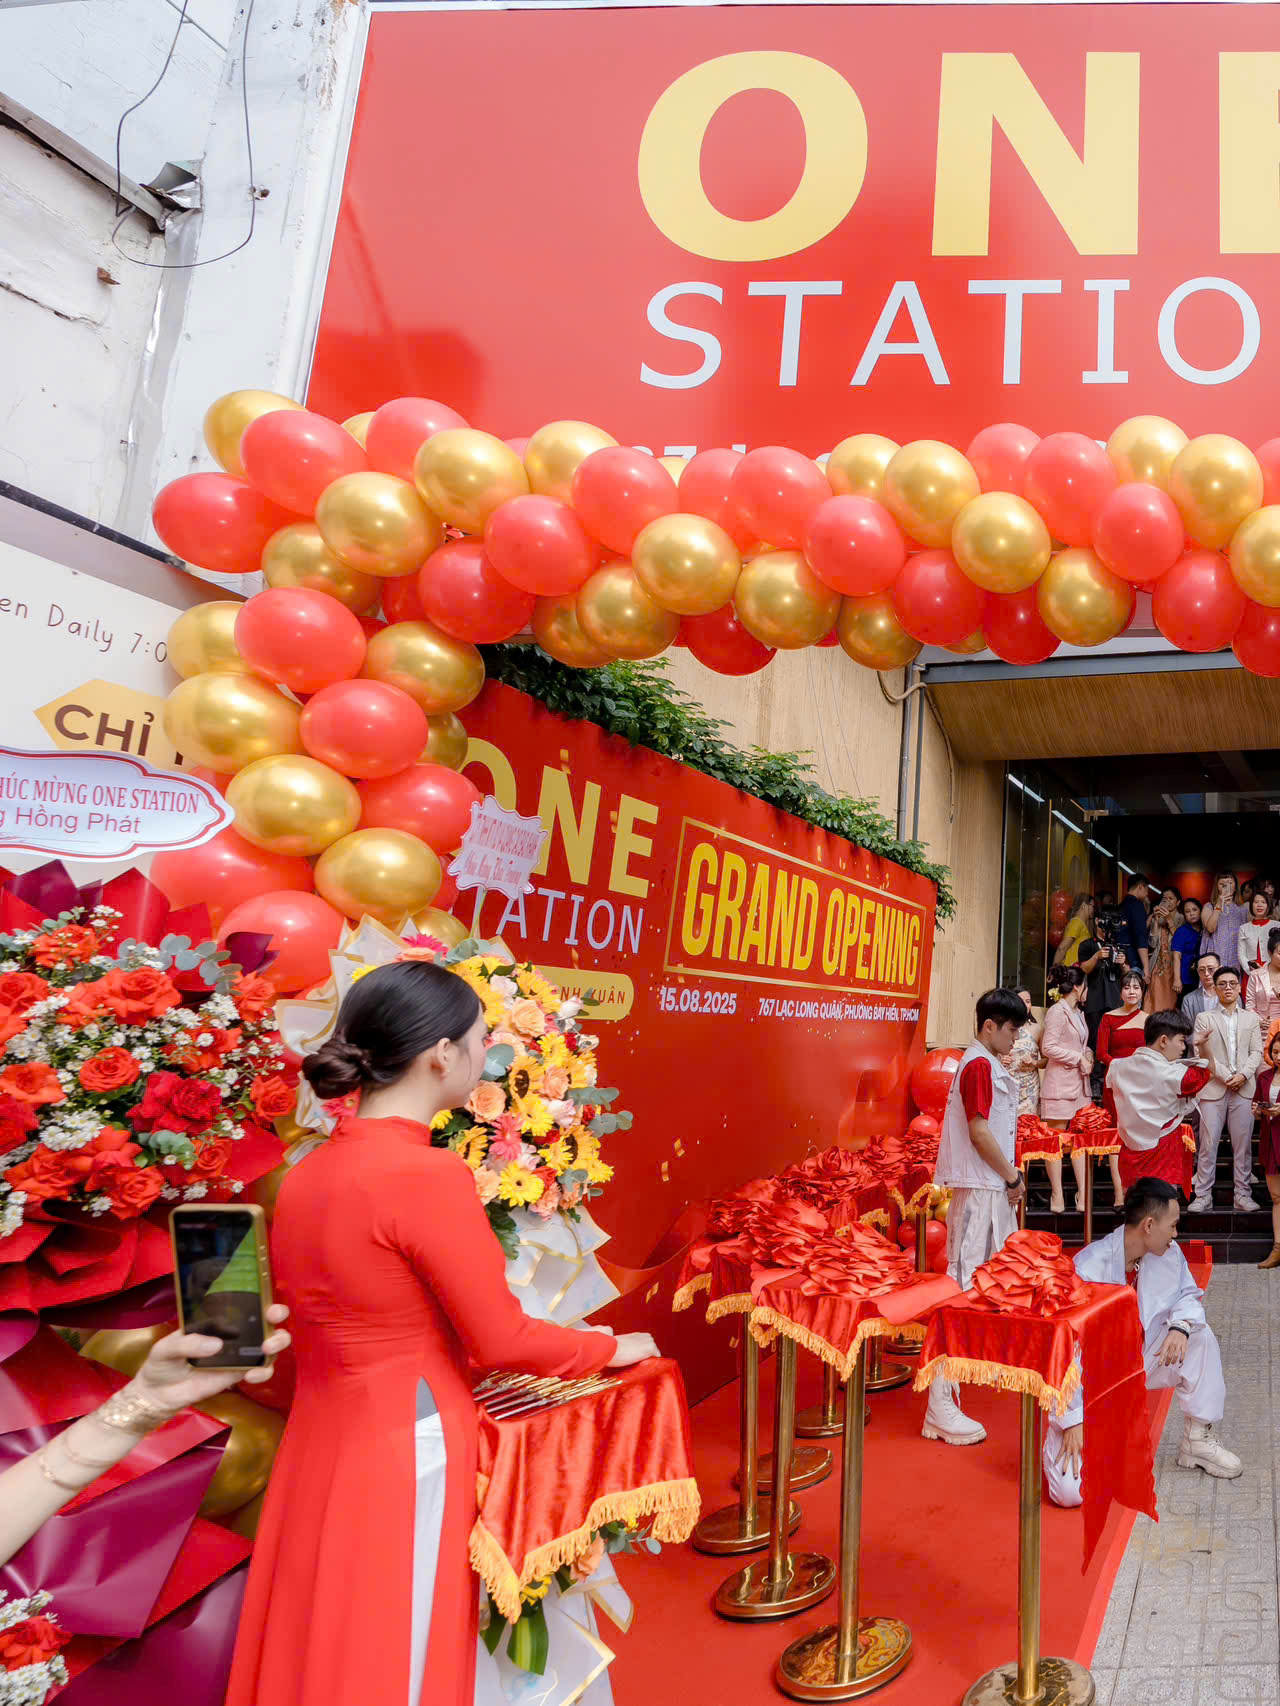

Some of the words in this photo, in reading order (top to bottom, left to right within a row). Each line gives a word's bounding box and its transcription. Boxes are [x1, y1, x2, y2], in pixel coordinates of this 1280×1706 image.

[47, 604, 114, 652] Daily
[130, 632, 168, 662] 7:0
[54, 704, 155, 757] CHỈ
[33, 775, 88, 805] MỪNG
[92, 785, 128, 808] ONE
[130, 788, 200, 813] STATION
[15, 804, 79, 834] Hồng
[87, 811, 142, 834] Phát
[681, 842, 820, 972] GRAND
[822, 887, 921, 986] OPENING
[659, 985, 738, 1015] 15.08.2025
[758, 998, 776, 1017] 767
[775, 999, 795, 1020] LẠC
[795, 1000, 819, 1018] LONG
